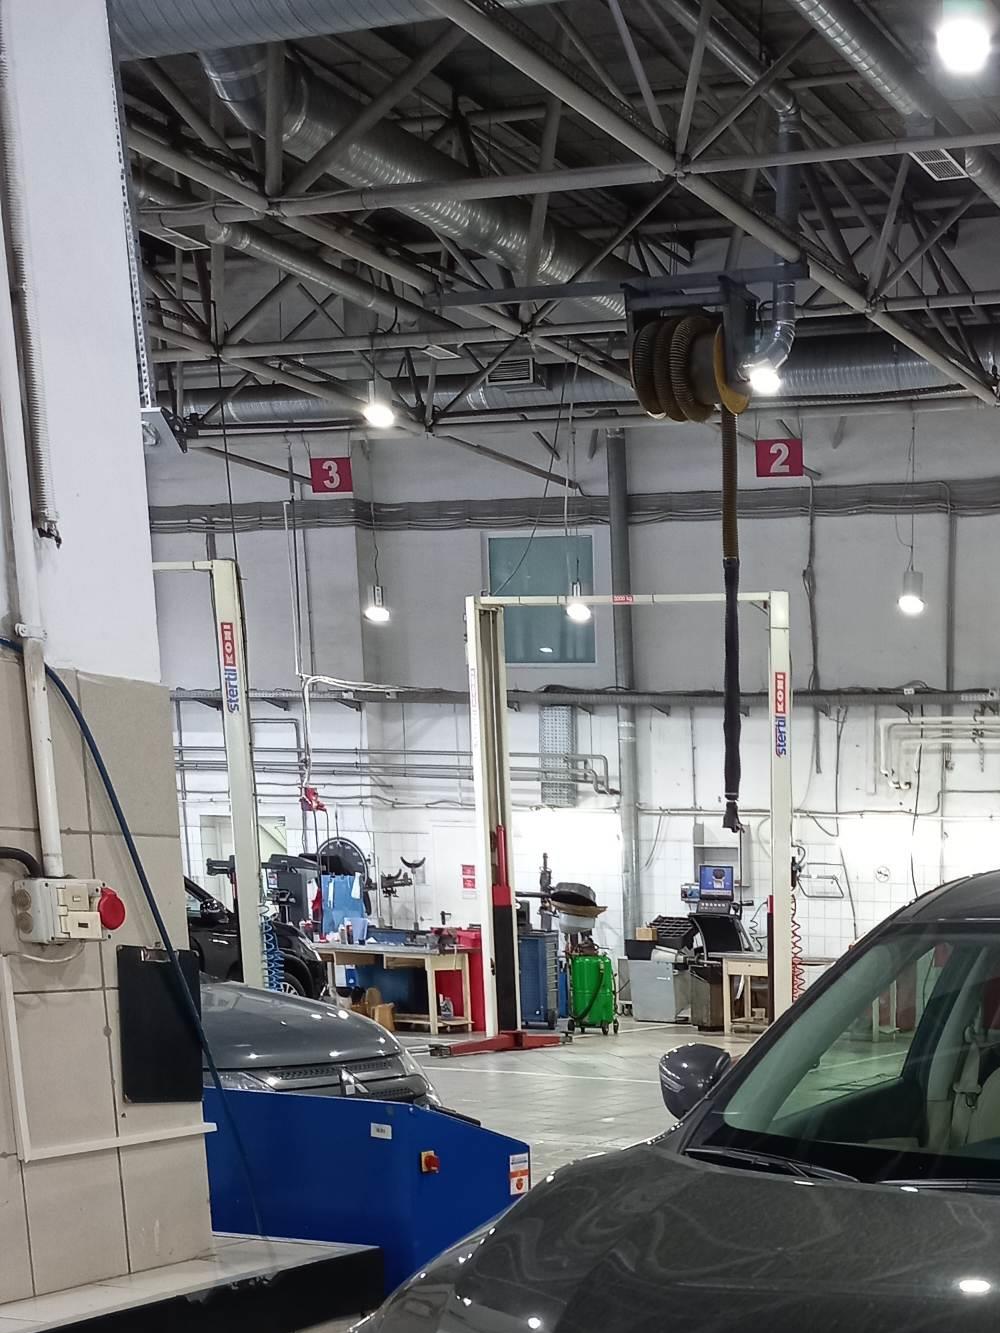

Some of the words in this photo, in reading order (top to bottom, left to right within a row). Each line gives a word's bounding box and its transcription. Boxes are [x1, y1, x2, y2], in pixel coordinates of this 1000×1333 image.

[769, 442, 790, 473] 2
[322, 460, 340, 489] 3
[224, 666, 240, 713] stertil
